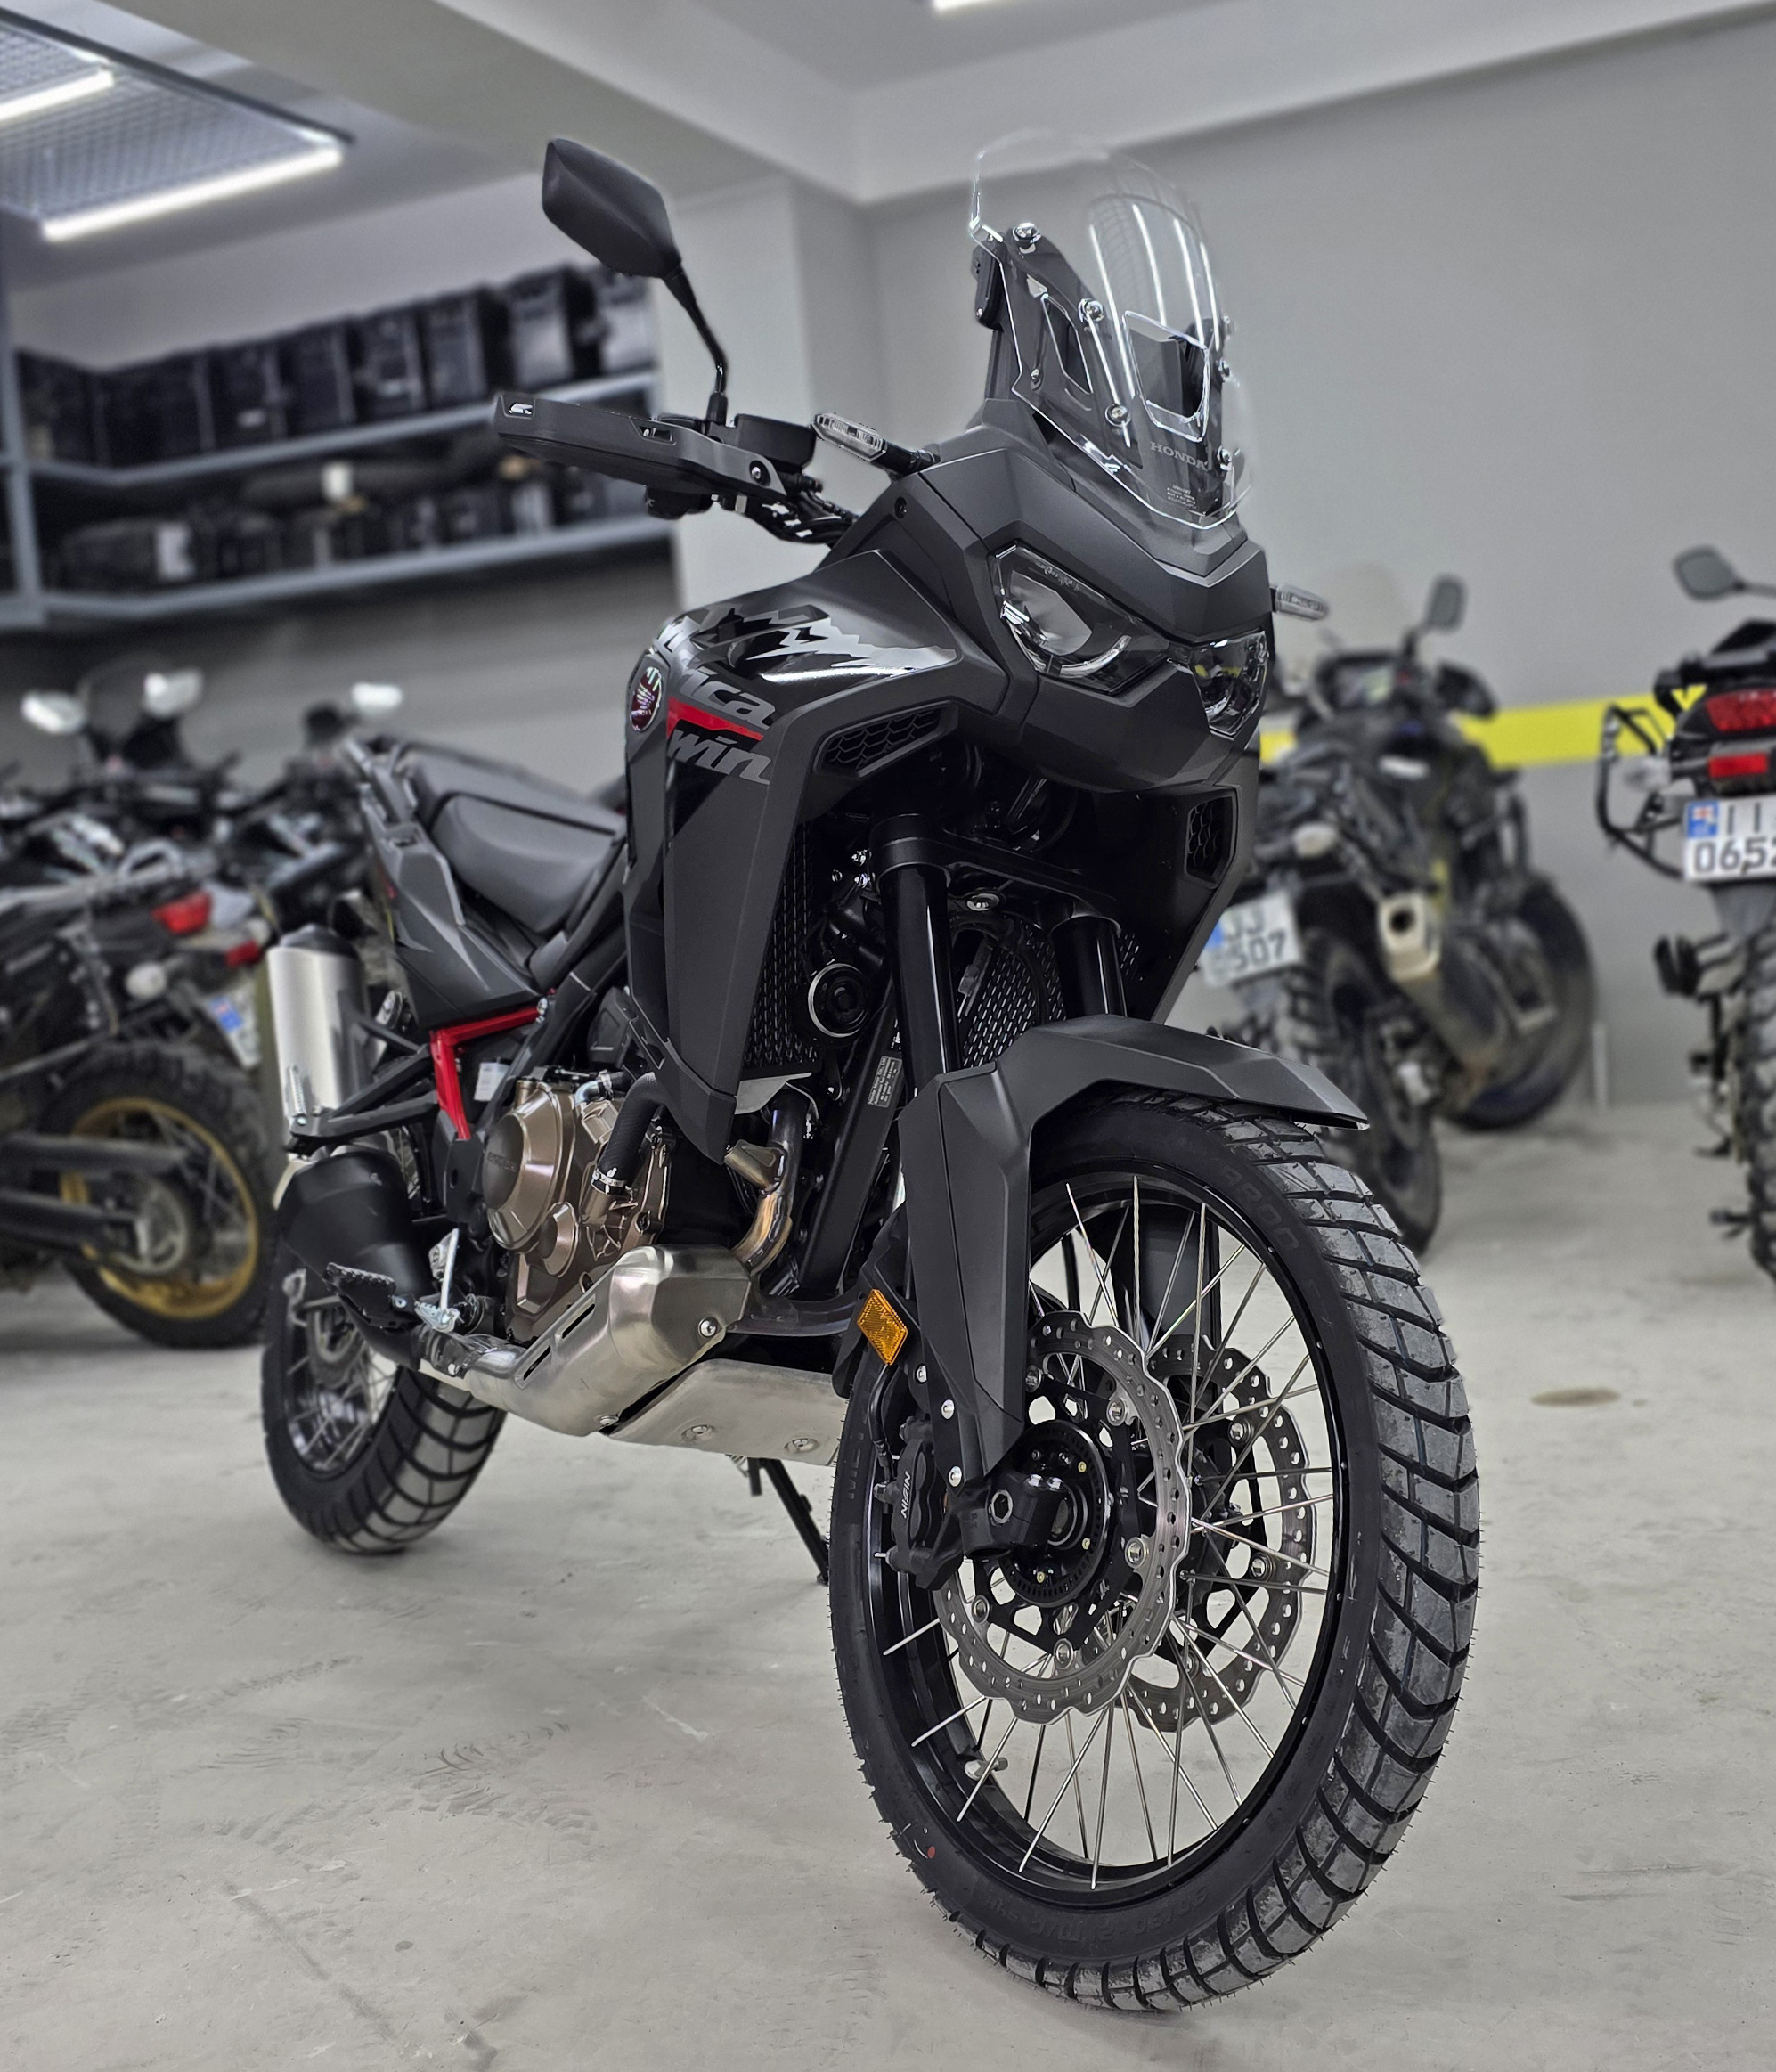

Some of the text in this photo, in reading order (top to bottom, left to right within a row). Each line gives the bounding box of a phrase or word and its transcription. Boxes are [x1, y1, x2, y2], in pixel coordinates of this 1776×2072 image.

[1150, 441, 1209, 472] HONDA
[1693, 836, 1776, 873] 065
[900, 1471, 912, 1519] NISSIN
